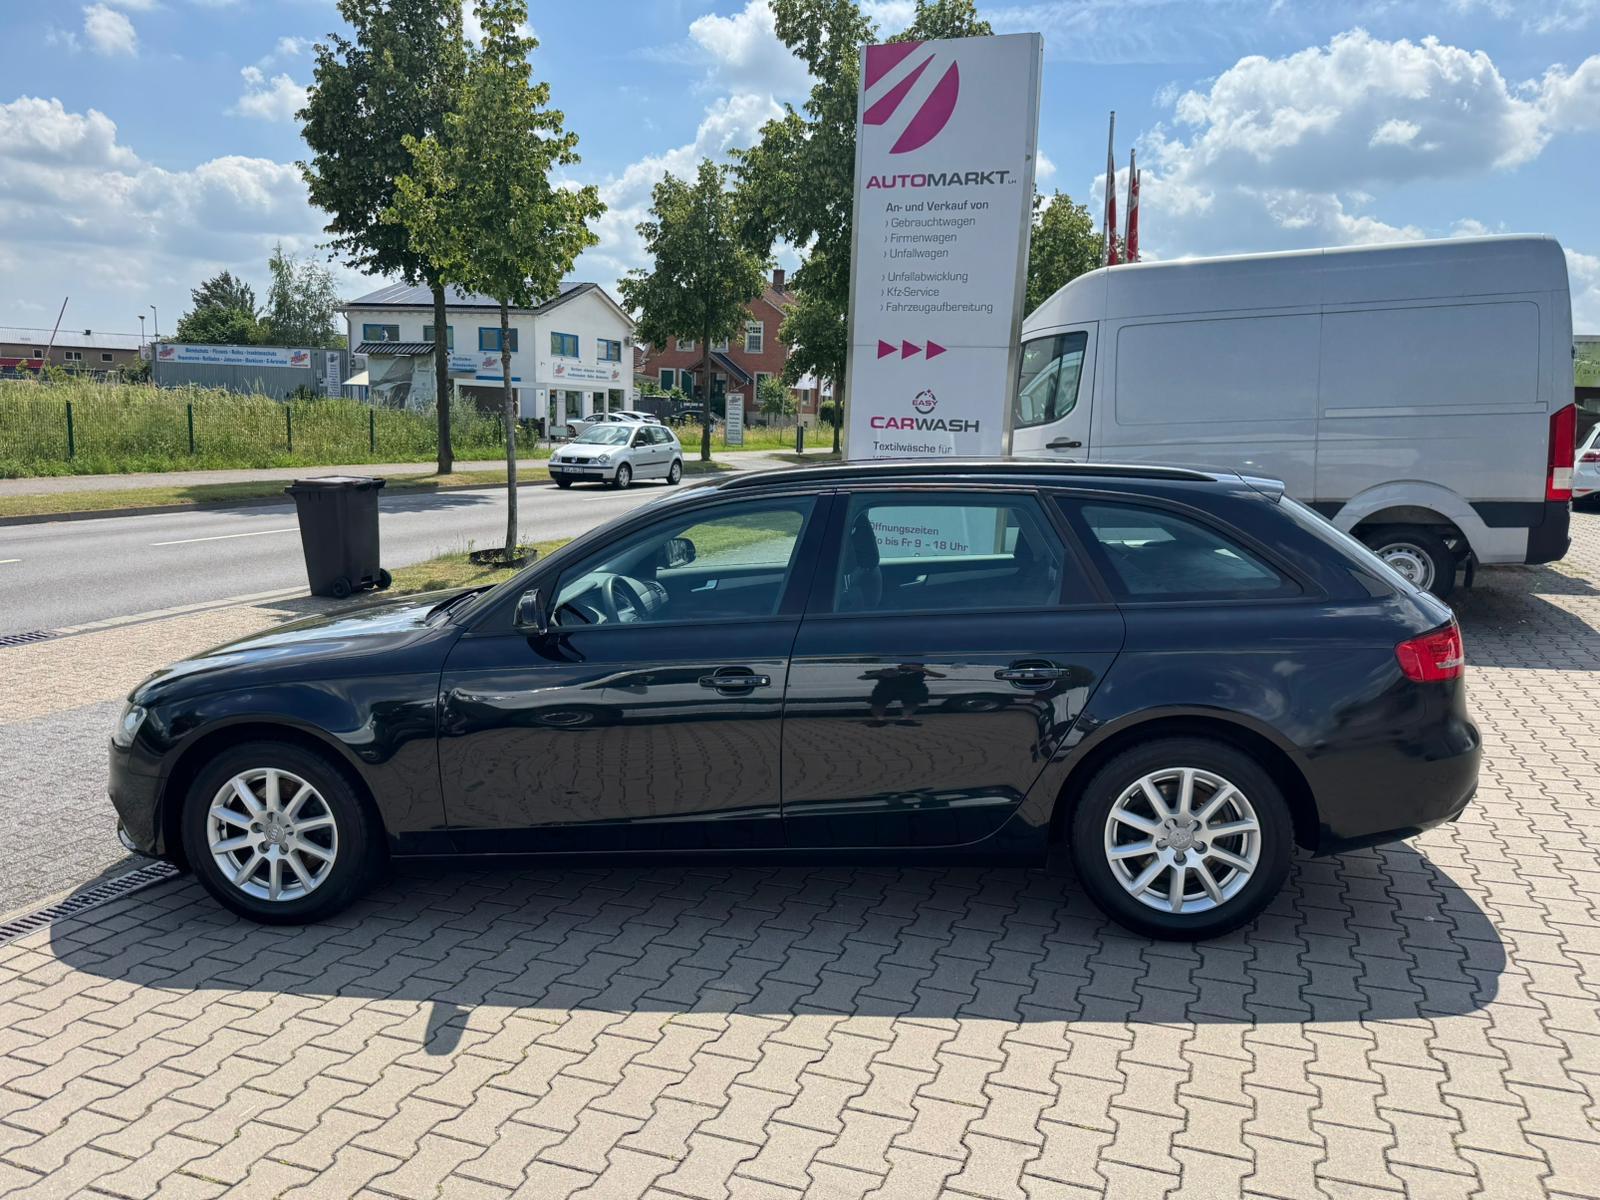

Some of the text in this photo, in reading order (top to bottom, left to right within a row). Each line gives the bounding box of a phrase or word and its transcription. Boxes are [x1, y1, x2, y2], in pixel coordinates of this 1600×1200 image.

[865, 170, 1010, 189] AUTOMARKT
[885, 200, 989, 213] An- und Verkauf von
[891, 216, 976, 229] Gebrauchtwagen
[890, 233, 957, 244] Firmenwagen
[889, 248, 949, 260] Unfallwagen
[887, 271, 969, 284] Unfallabwicklung
[886, 287, 940, 298] Kfz-Service
[885, 302, 993, 314] Fahrzeugaufbereitung
[912, 399, 938, 407] EASY
[870, 416, 980, 433] CARWASH
[873, 441, 953, 455] Textilwäsche für
[885, 536, 899, 546] bis
[901, 538, 912, 548] Fr
[914, 538, 922, 548] 9
[933, 540, 947, 550] 18
[949, 542, 969, 552] Uhr
